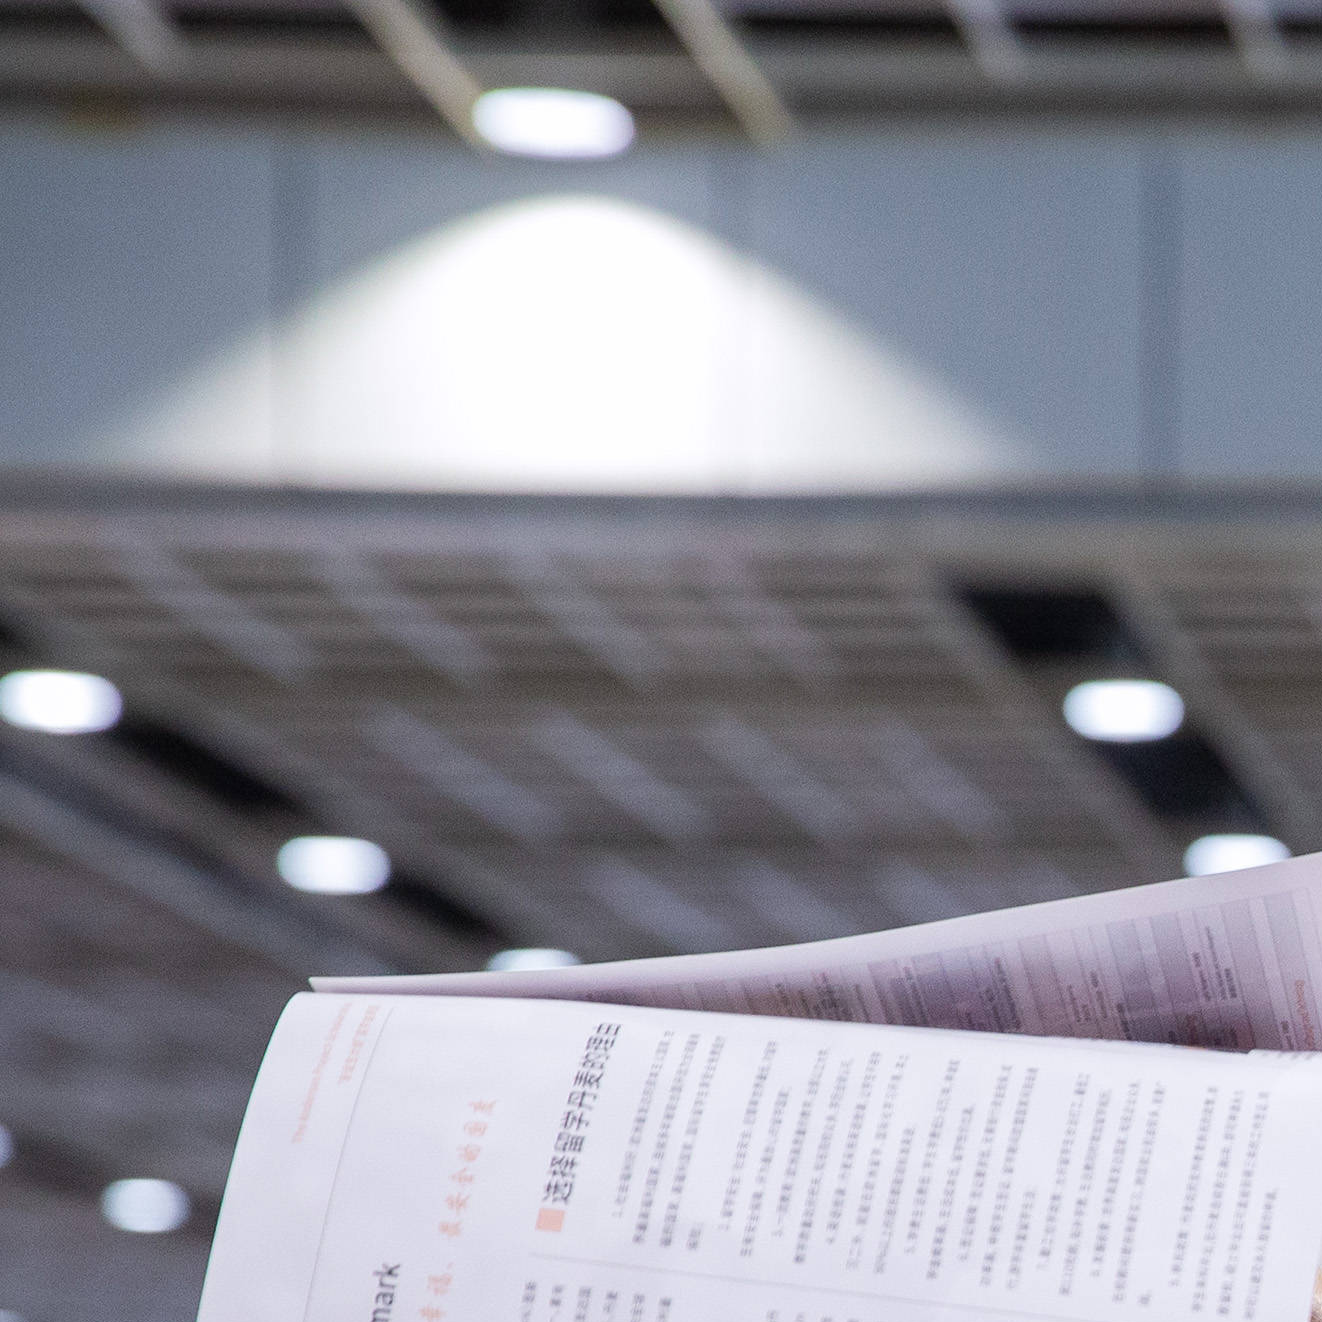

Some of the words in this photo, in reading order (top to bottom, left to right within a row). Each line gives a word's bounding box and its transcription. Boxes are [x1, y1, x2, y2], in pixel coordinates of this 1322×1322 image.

[543, 1022, 621, 1204] 选择留学丹麦的理由
